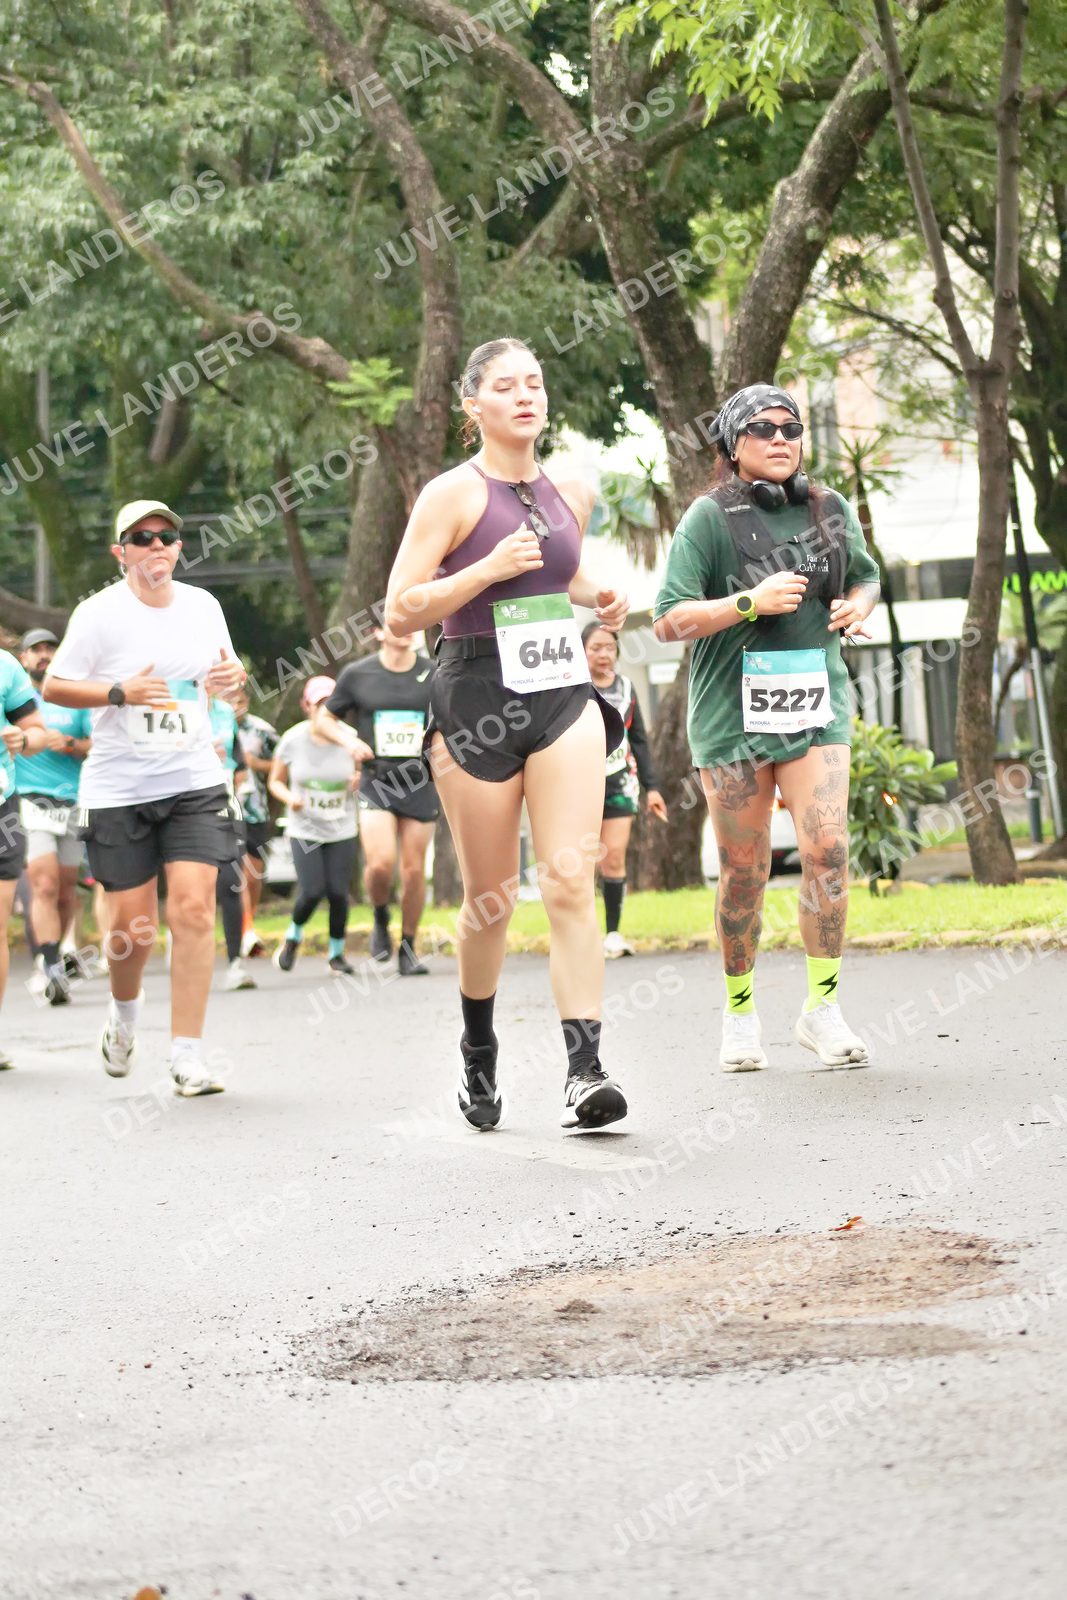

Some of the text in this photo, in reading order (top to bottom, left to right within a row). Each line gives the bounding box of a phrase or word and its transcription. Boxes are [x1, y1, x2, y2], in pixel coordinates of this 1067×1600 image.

[518, 636, 574, 669] 644
[749, 687, 825, 713] 5227
[143, 712, 187, 734] 141
[385, 732, 415, 745] 307
